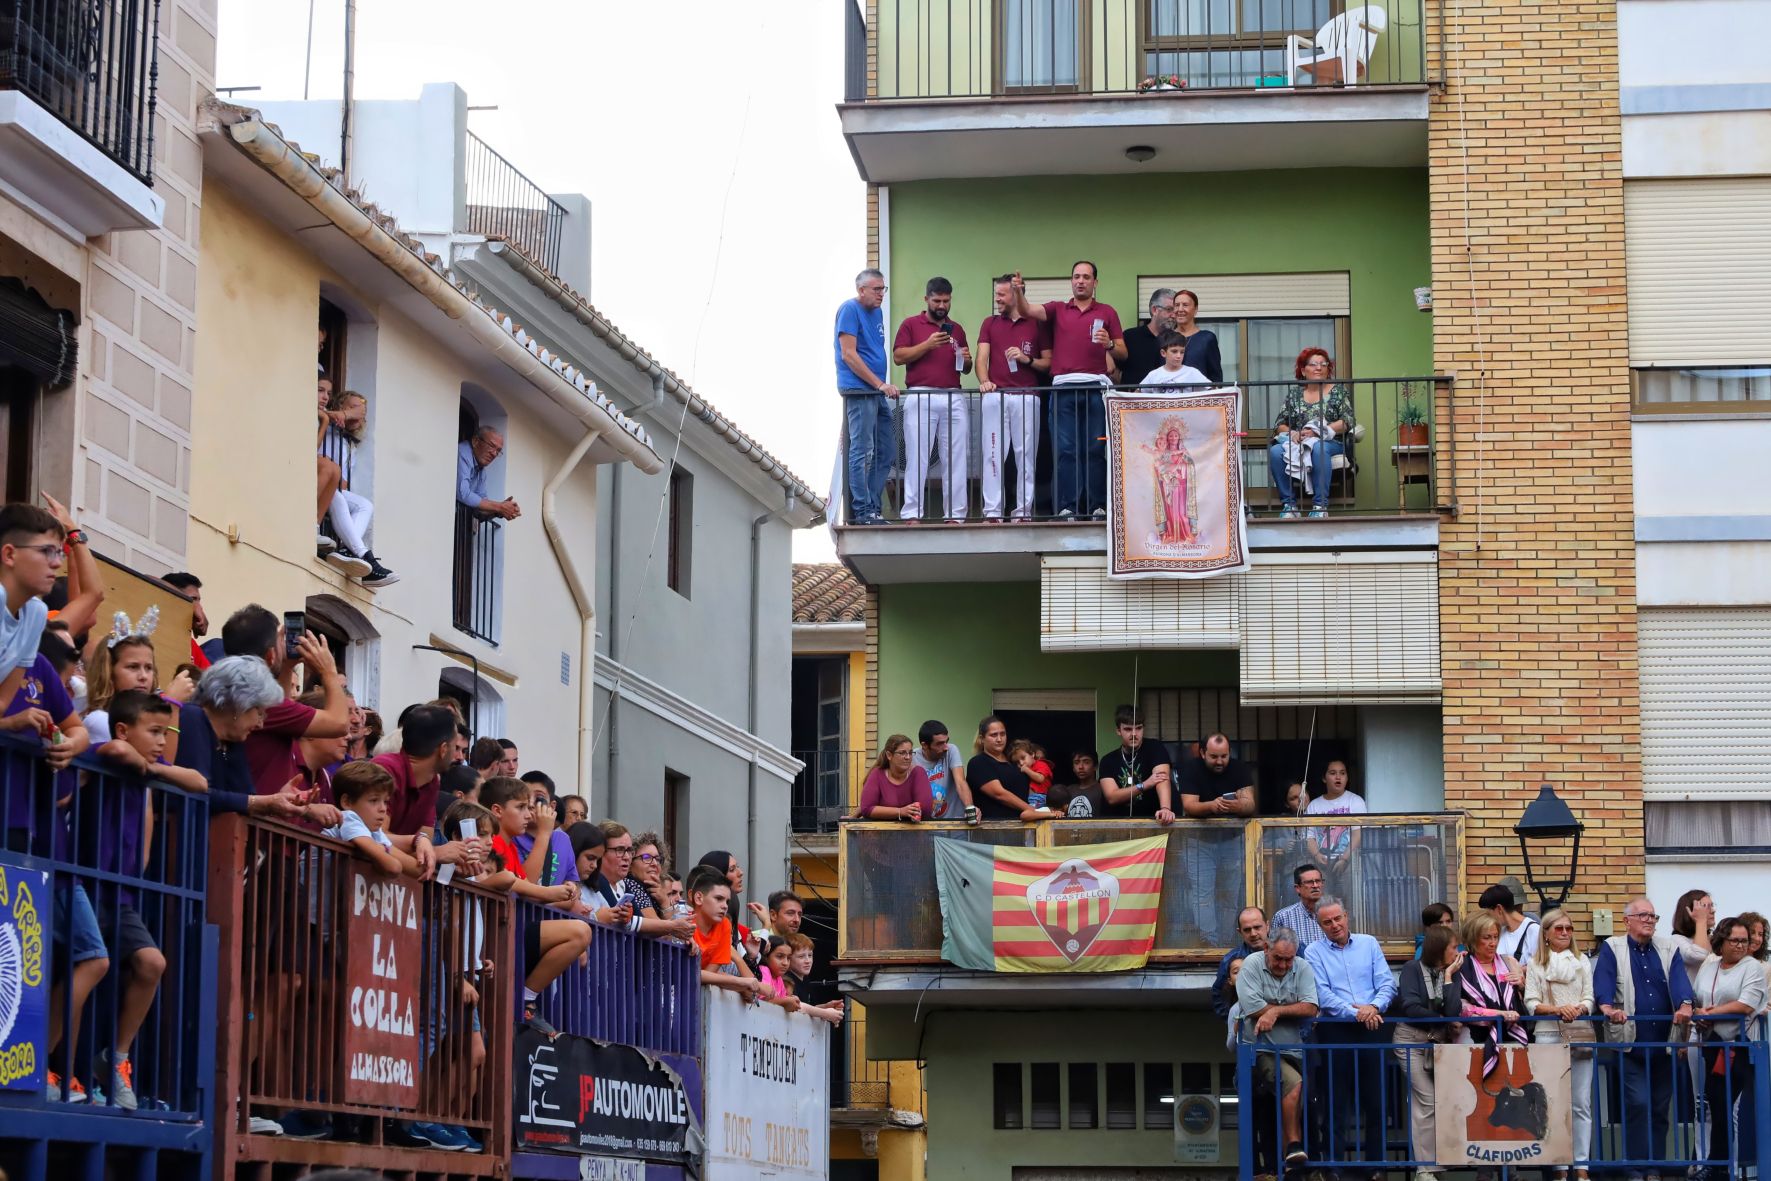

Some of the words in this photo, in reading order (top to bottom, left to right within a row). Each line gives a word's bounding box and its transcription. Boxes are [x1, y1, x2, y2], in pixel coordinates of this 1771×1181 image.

[1055, 889, 1111, 901] CASTELLON
[372, 934, 397, 980] LA
[351, 986, 415, 1037] COLLA
[350, 1052, 414, 1087] ALMASSORA
[723, 1112, 752, 1158] TOTS
[1466, 1143, 1542, 1162] CLAFIDORS
